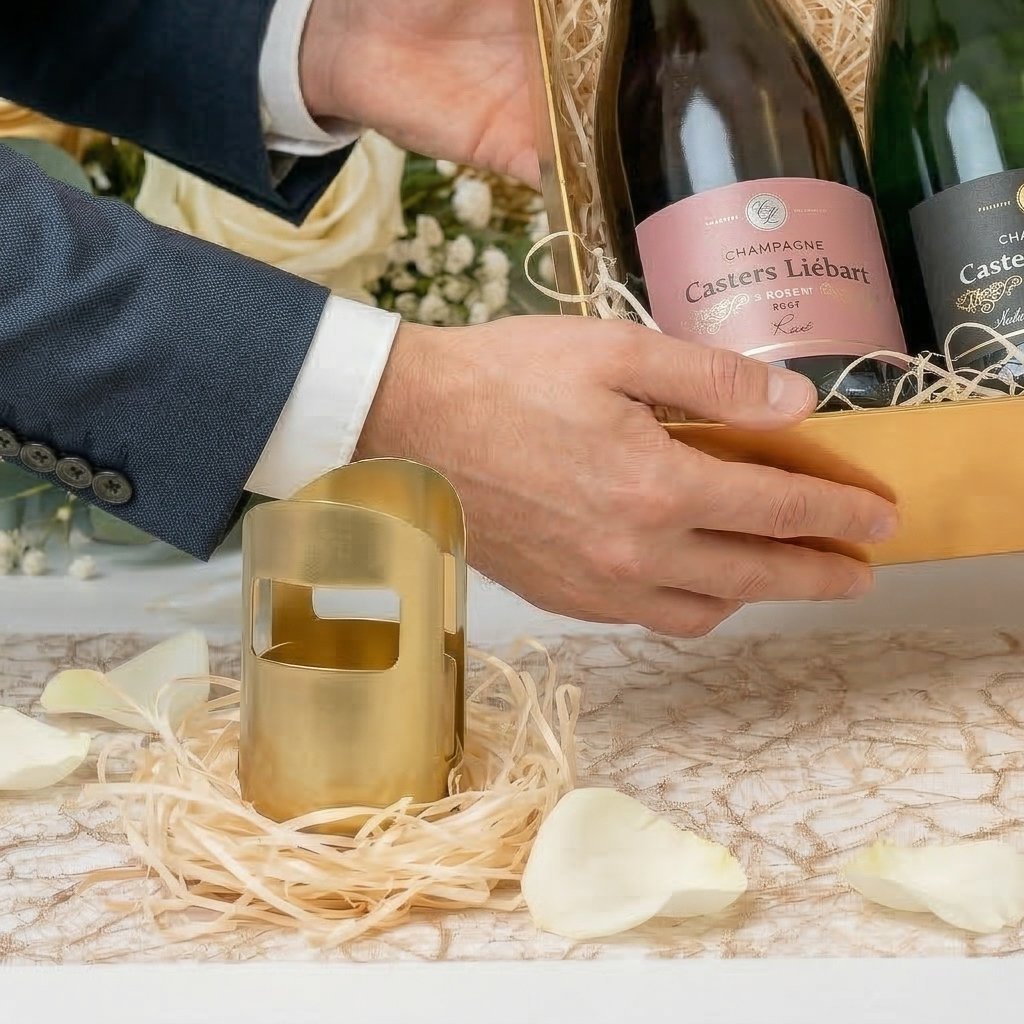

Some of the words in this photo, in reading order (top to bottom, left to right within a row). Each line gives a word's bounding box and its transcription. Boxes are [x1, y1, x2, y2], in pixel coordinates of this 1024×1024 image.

[725, 240, 825, 262] CHAMPAGNE
[684, 263, 778, 304] Casters
[785, 257, 871, 285] Liébart
